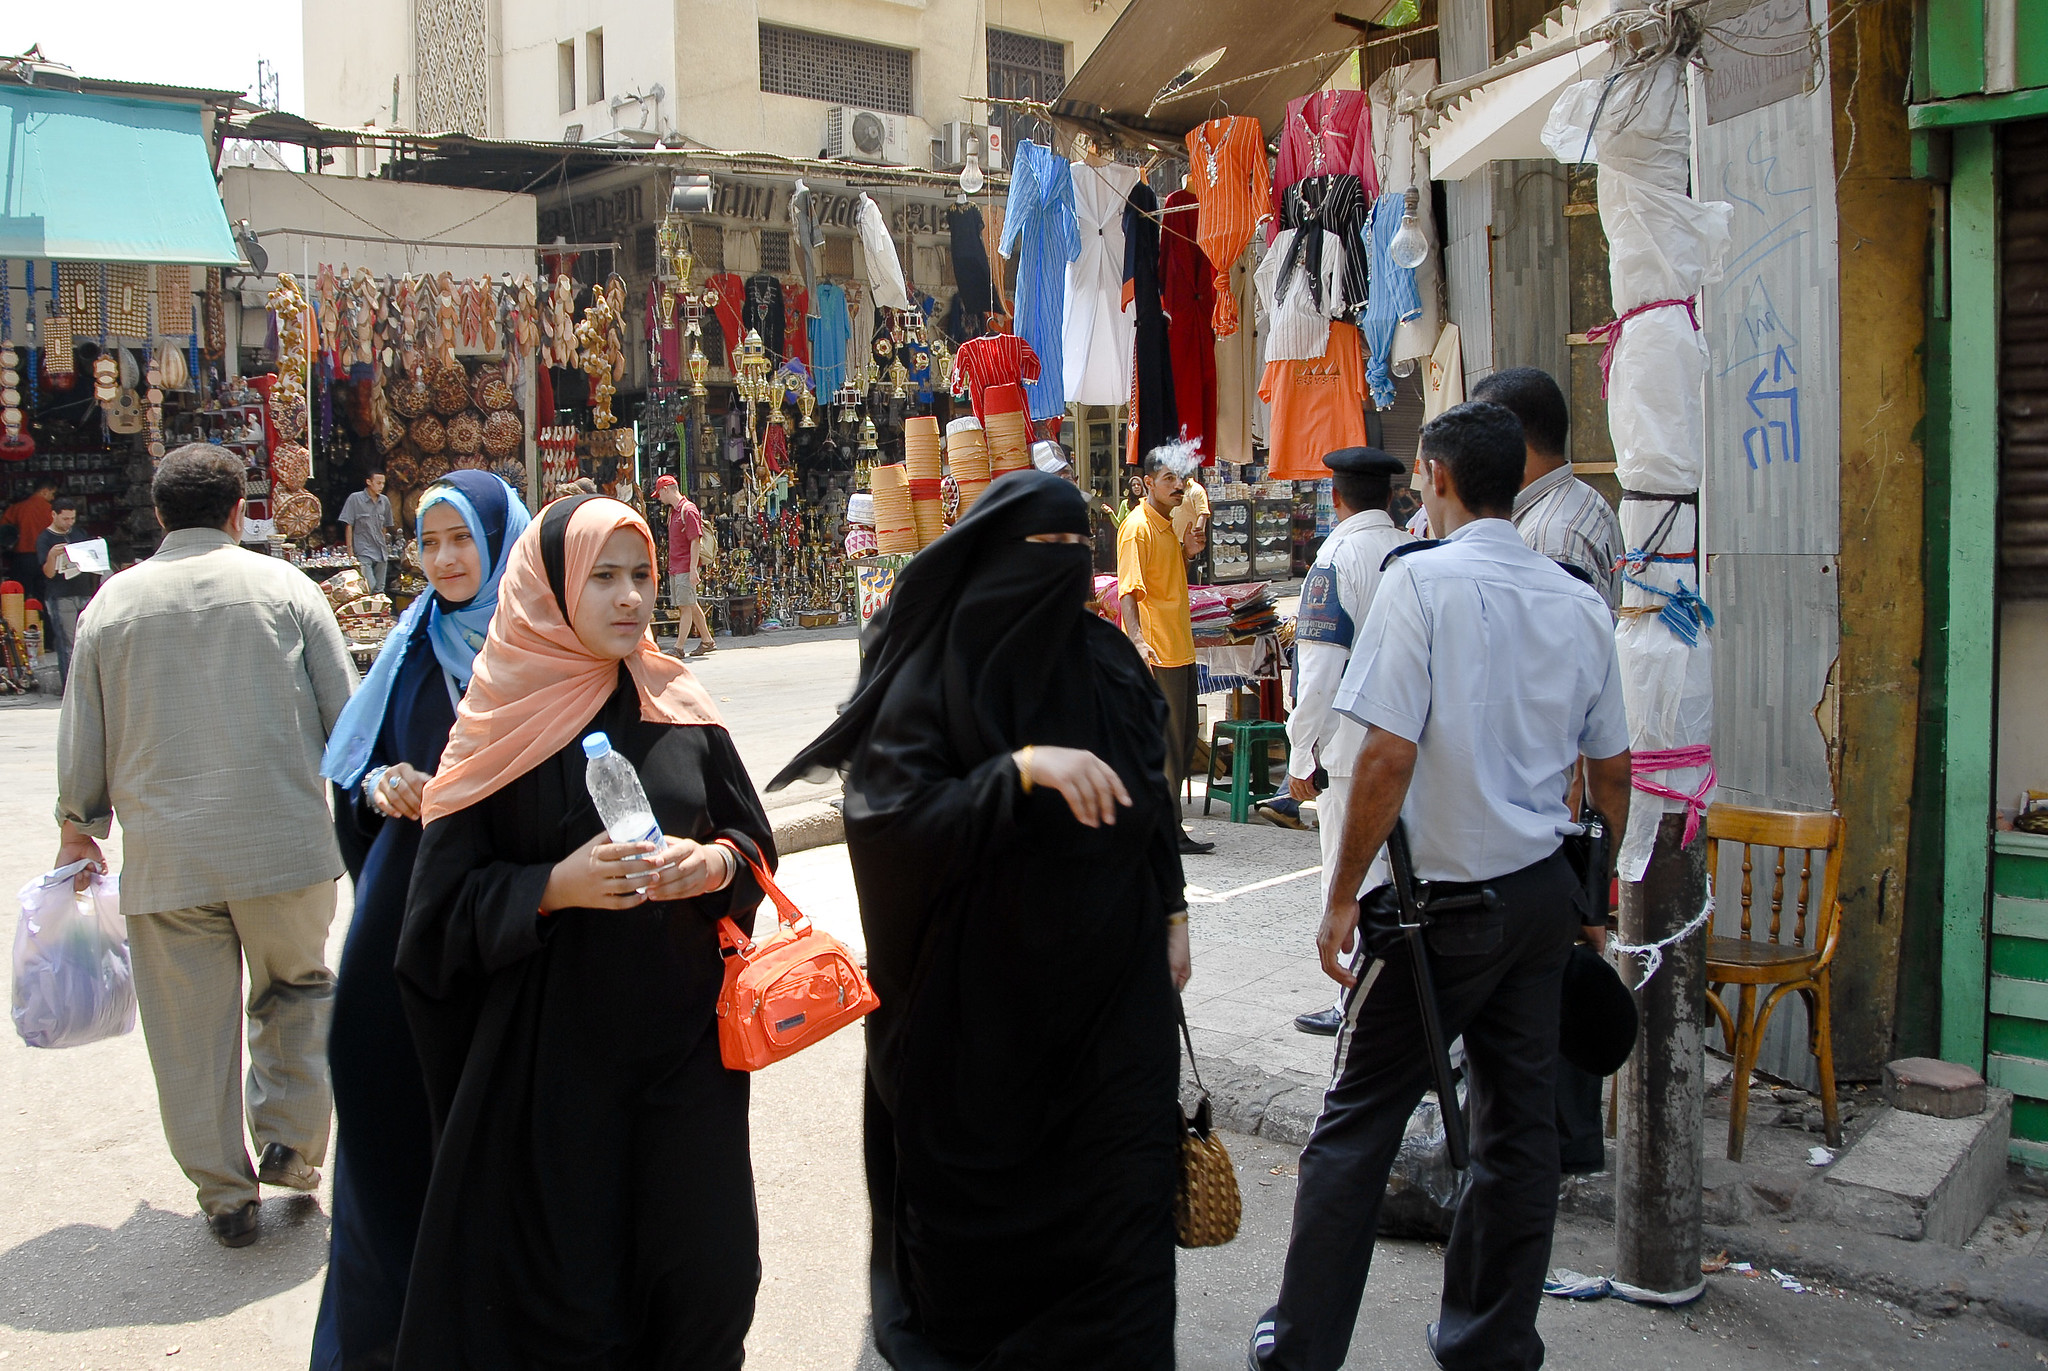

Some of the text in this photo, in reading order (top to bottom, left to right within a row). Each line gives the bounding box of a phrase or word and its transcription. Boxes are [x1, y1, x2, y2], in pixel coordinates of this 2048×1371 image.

[1705, 40, 1812, 104] RADWAN HOTEL
[1296, 376, 1339, 385] EGYPT
[1299, 627, 1322, 638] POLICE
